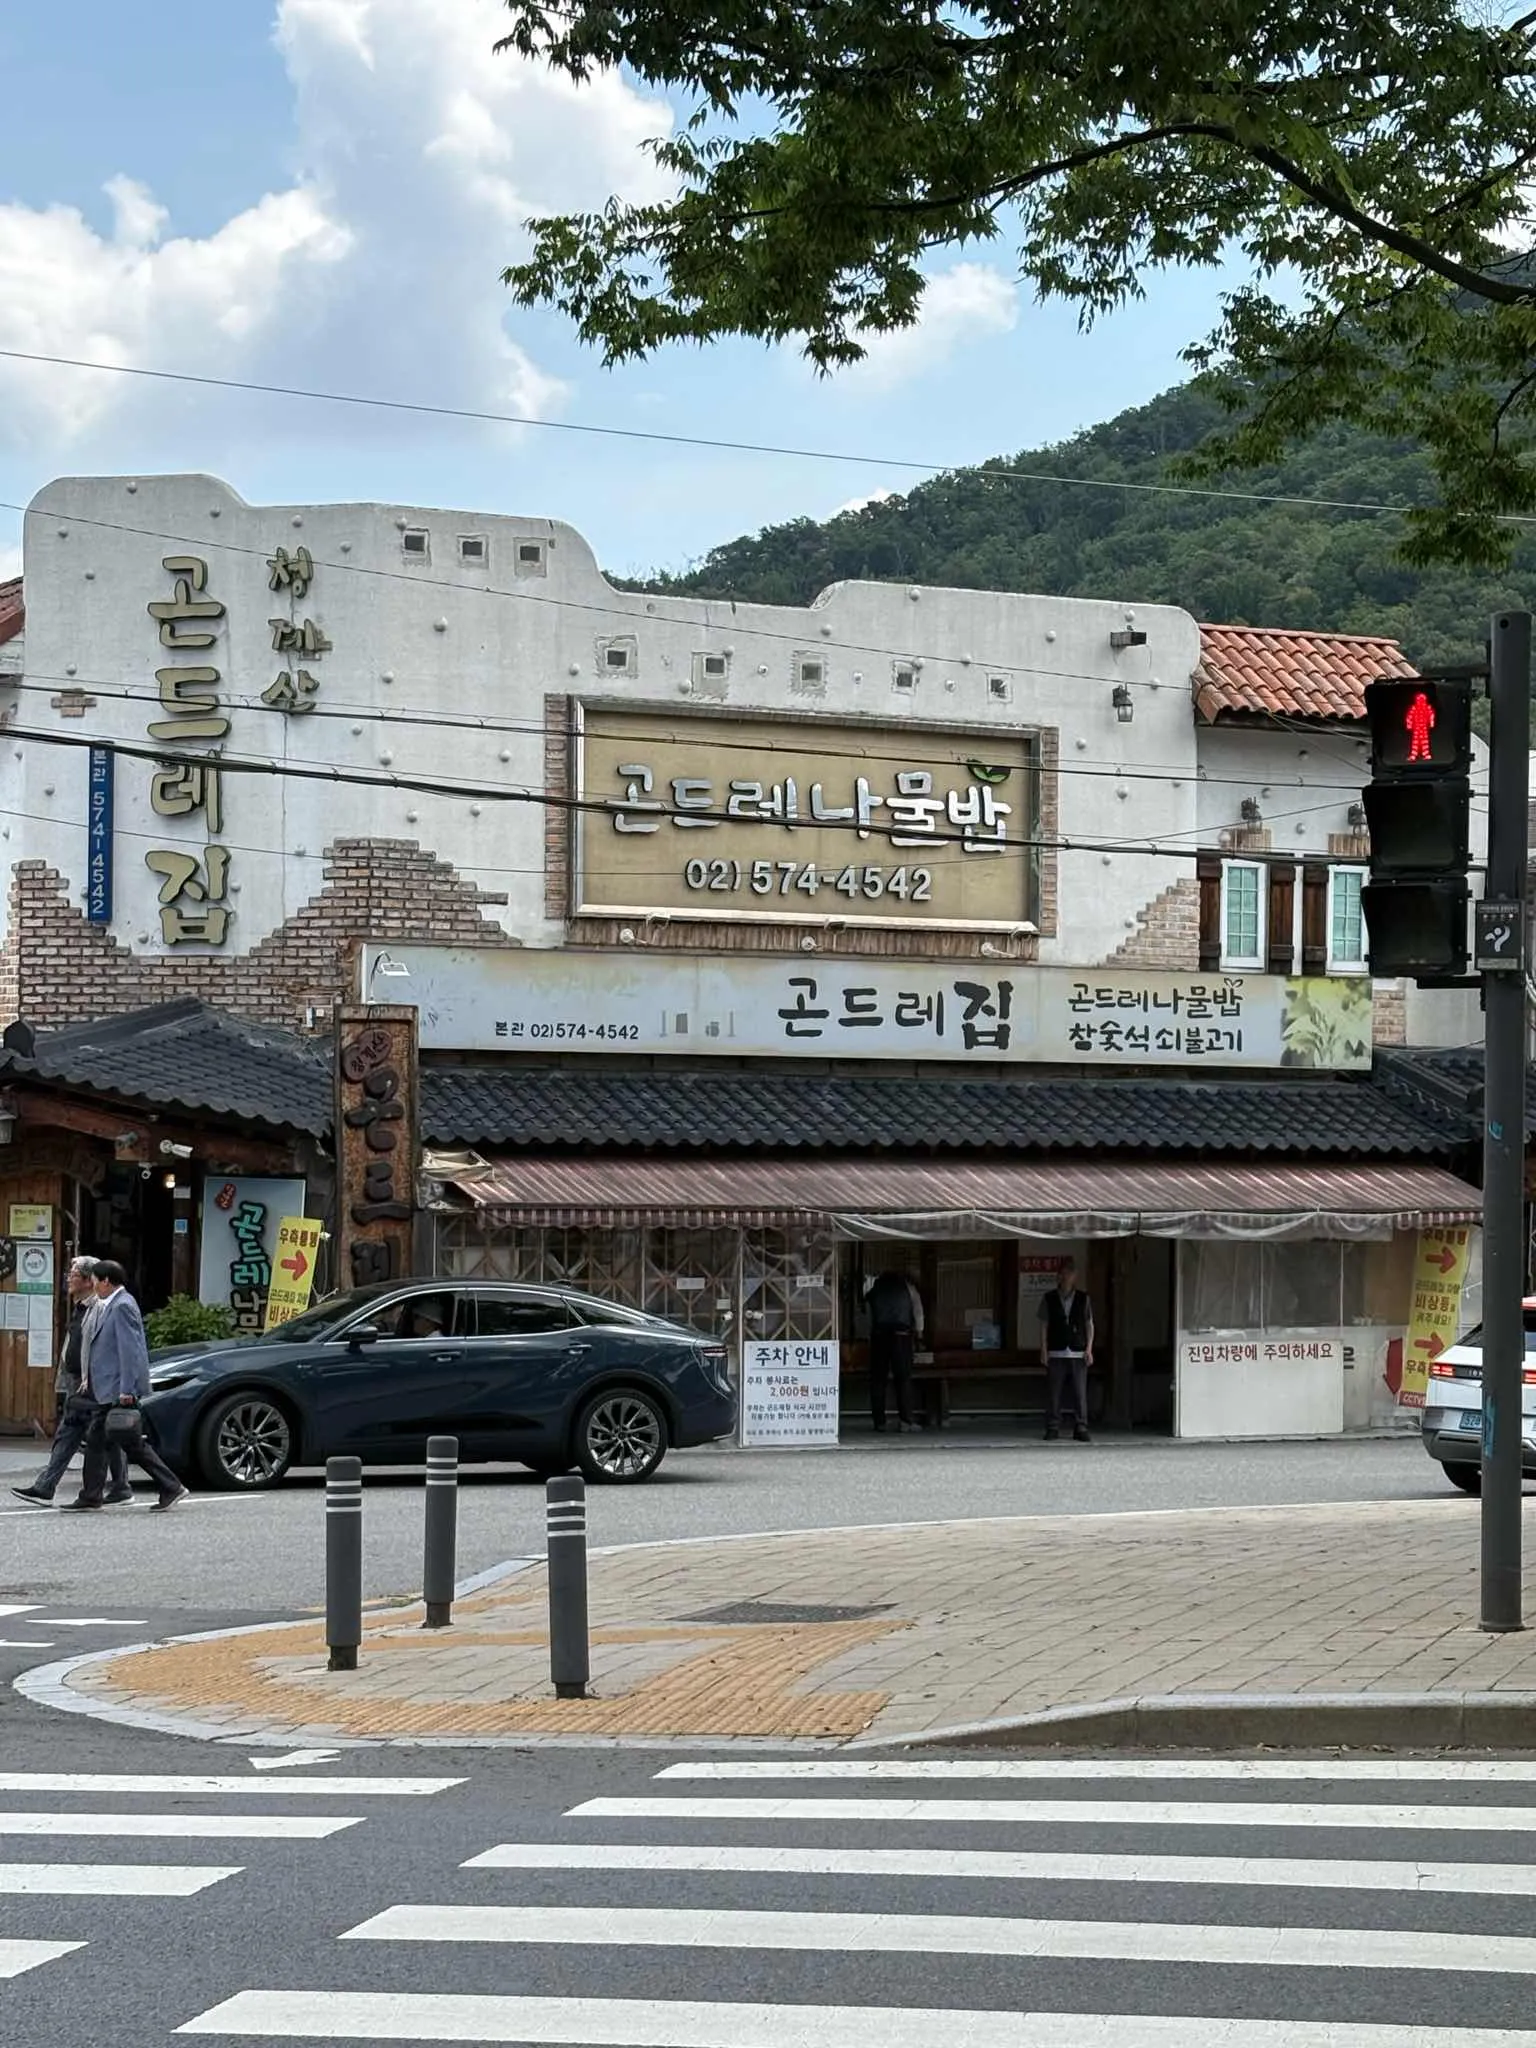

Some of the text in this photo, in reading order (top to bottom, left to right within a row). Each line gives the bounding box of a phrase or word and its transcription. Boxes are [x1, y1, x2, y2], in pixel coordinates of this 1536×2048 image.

[260, 545, 321, 714] 청계산
[145, 555, 232, 946] 곤드레집
[610, 763, 1013, 853] 곤드레나물밥
[92, 791, 105, 914] 574-4542
[777, 977, 1014, 1050] 곤드레집
[1067, 979, 1242, 1018] 곤드레나물밥
[495, 1020, 639, 1041] 본관 02)574-4542
[755, 1346, 828, 1366] 주차 안내
[1187, 1345, 1257, 1363] 진입차량에
[1263, 1343, 1333, 1361] 주의하세요
[770, 1386, 809, 1397] 2,000원
